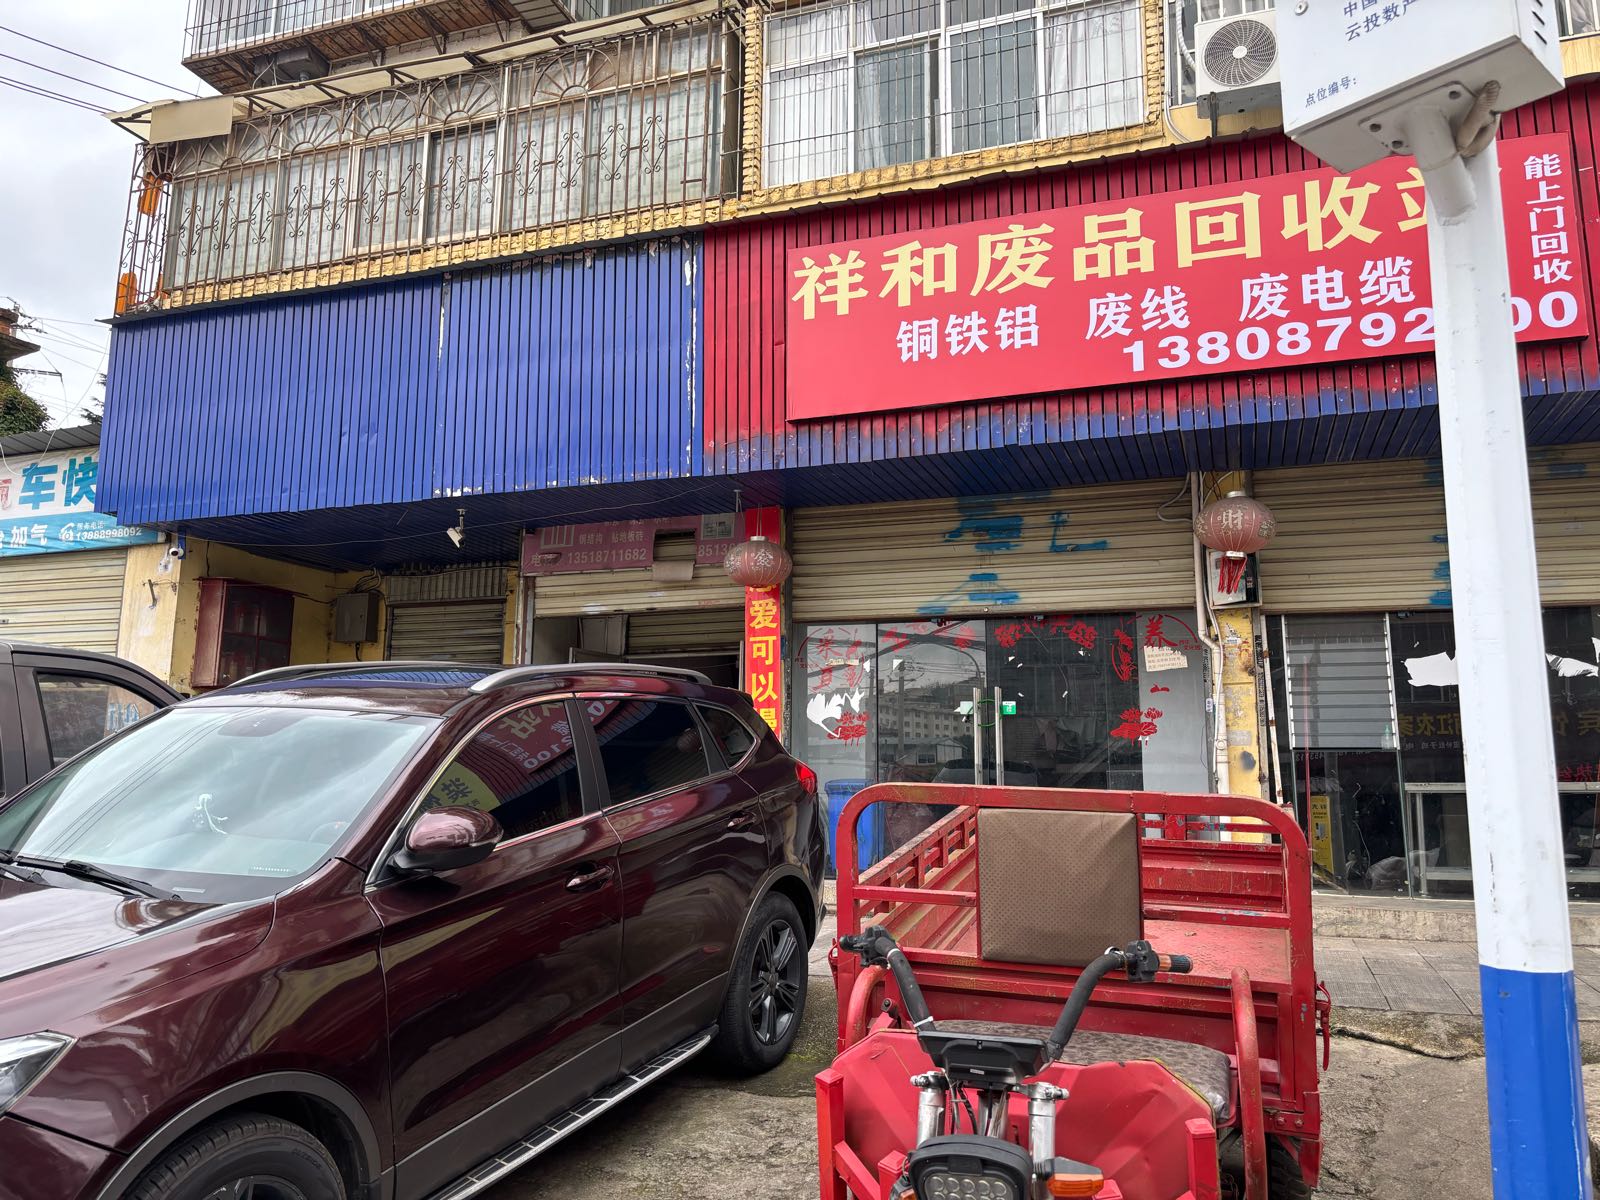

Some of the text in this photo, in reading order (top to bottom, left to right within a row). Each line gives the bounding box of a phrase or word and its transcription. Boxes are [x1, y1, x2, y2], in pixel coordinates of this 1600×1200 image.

[1523, 153, 1573, 285] 能上门回收
[896, 256, 1415, 362] 铜铁铝 废线 废电缆
[1123, 291, 1578, 372] 1380879200
[77, 527, 142, 541] 13888998092
[567, 547, 647, 565] 13518711682
